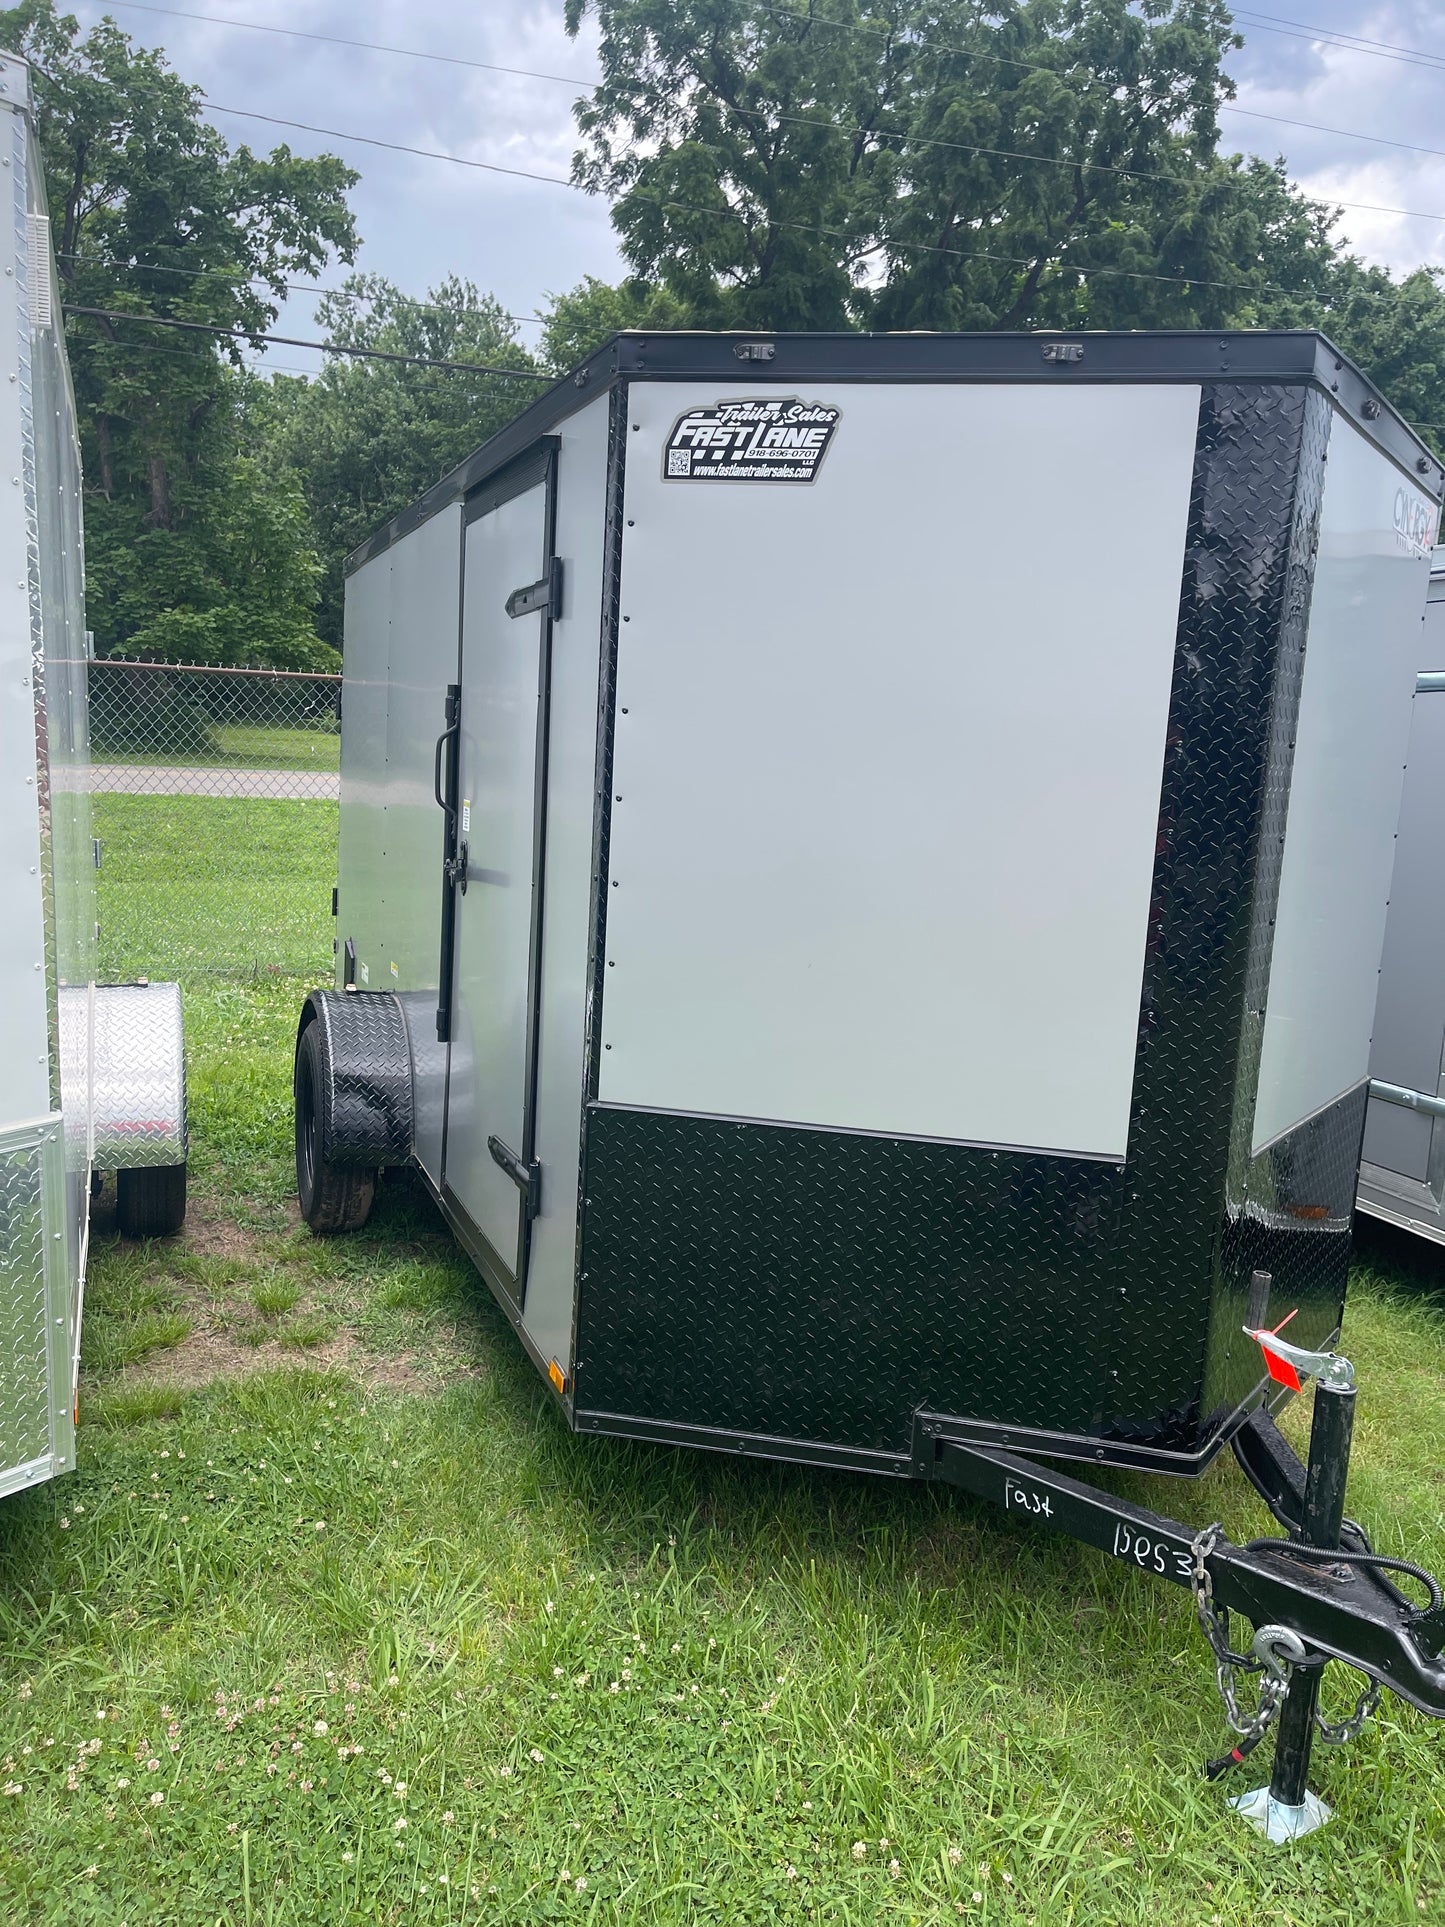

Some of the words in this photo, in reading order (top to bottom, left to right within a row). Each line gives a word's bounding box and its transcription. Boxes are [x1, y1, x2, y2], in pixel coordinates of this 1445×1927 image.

[719, 404, 782, 423] Trailer
[784, 405, 837, 424] Sales
[747, 449, 817, 458] 918-696-0701
[693, 463, 814, 479] www.fastlanetrailersales.com
[1005, 1477, 1054, 1518] Fast
